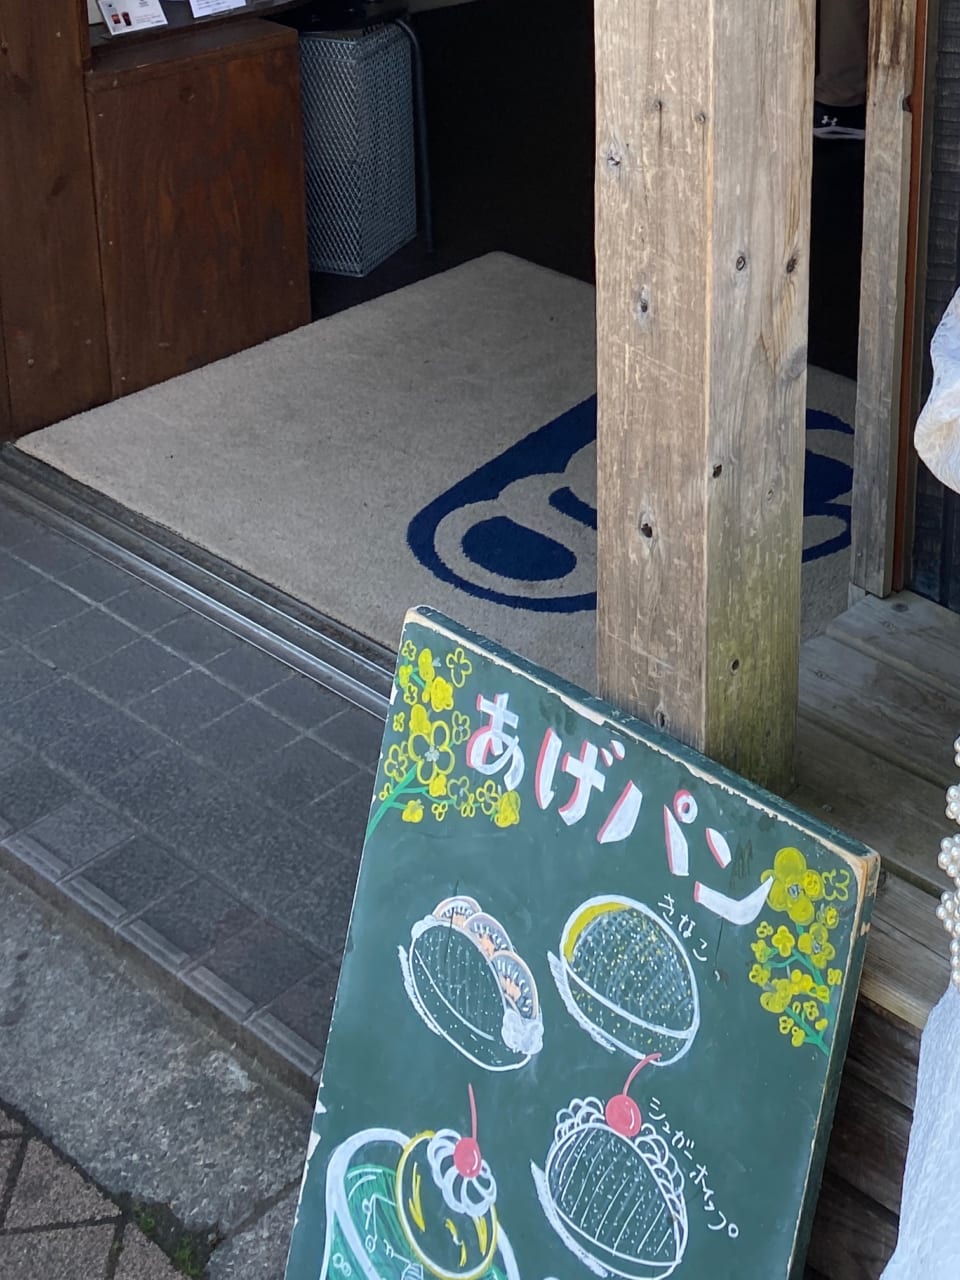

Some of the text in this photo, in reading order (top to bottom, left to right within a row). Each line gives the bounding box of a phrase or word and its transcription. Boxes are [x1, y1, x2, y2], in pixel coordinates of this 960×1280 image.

[466, 692, 774, 926] あげパン
[657, 893, 708, 962] きなこ
